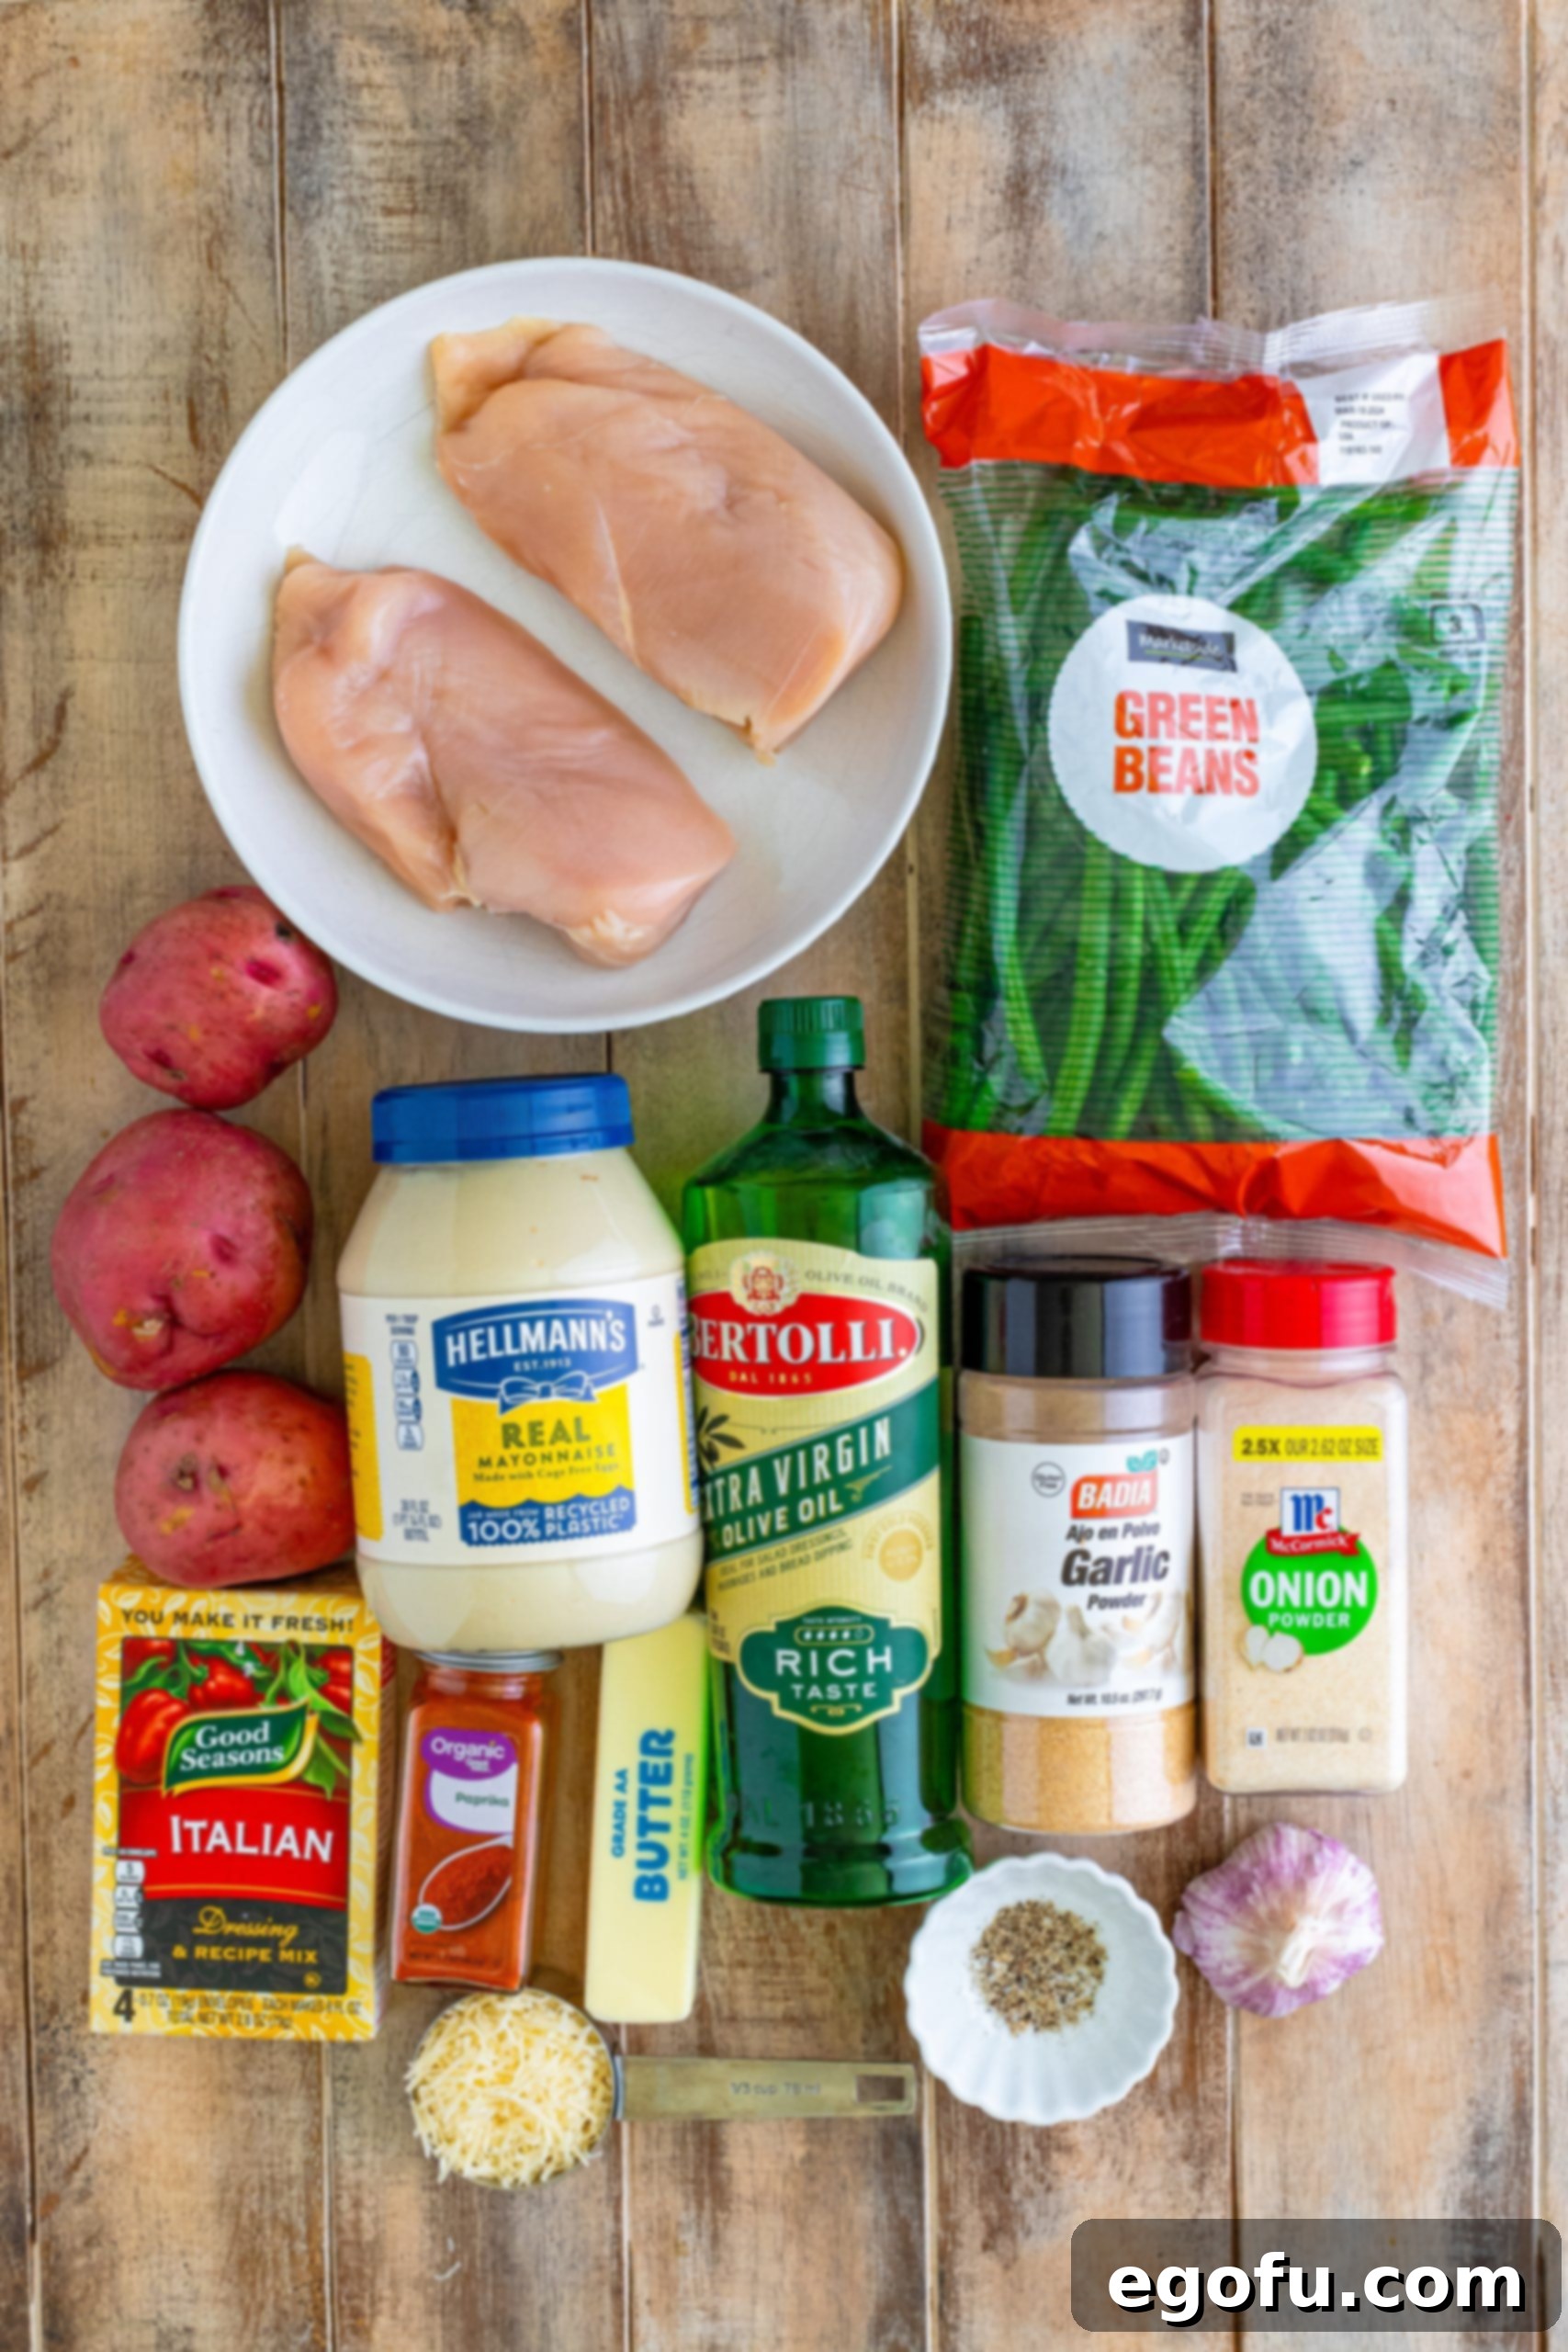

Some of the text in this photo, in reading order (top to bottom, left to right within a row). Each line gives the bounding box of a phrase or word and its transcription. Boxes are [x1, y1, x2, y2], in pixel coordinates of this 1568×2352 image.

[1114, 690, 1259, 743] GREEN
[1113, 745, 1259, 797] BEANS
[805, 1271, 853, 1284] OLIVE
[858, 1275, 883, 1290] OIL
[446, 1310, 626, 1367] HELLMANN'S
[502, 1417, 590, 1450] REAL
[1242, 1437, 1280, 1456] 2.5X
[478, 1443, 615, 1469] MAYONNAISE
[773, 1416, 892, 1497] VIRGIN
[473, 1473, 504, 1483] Made
[509, 1470, 533, 1481] with
[1077, 1479, 1152, 1510] BADIA
[544, 1497, 629, 1521] RECYCLED
[722, 1490, 843, 1550] OLIVE OIL
[468, 1518, 541, 1542] 100%
[545, 1516, 621, 1536] PLASTIC
[1066, 1521, 1160, 1544] Ajo en Polvo
[1270, 1533, 1348, 1551] McCormick
[1061, 1545, 1170, 1587] Garlic
[1087, 1592, 1146, 1611] Powder
[1249, 1570, 1368, 1608] ONION
[122, 1610, 355, 1633] YOU MAKE IT FRESH!
[1268, 1611, 1350, 1629] POWDER
[775, 1645, 892, 1677] RICH
[791, 1682, 877, 1700] TASTE
[196, 1720, 270, 1749] Good
[180, 1745, 284, 1771] Seasons
[430, 1736, 505, 1762] Organic
[455, 1791, 510, 1808] Paprika
[611, 1769, 629, 1858] GRADE AA
[633, 1728, 675, 1903] BUTTER
[169, 1815, 334, 1863] ITALIAN
[192, 1905, 299, 1949] Dressing
[172, 1944, 319, 1964] & RECIPE MIX
[113, 1988, 136, 2023] 4
